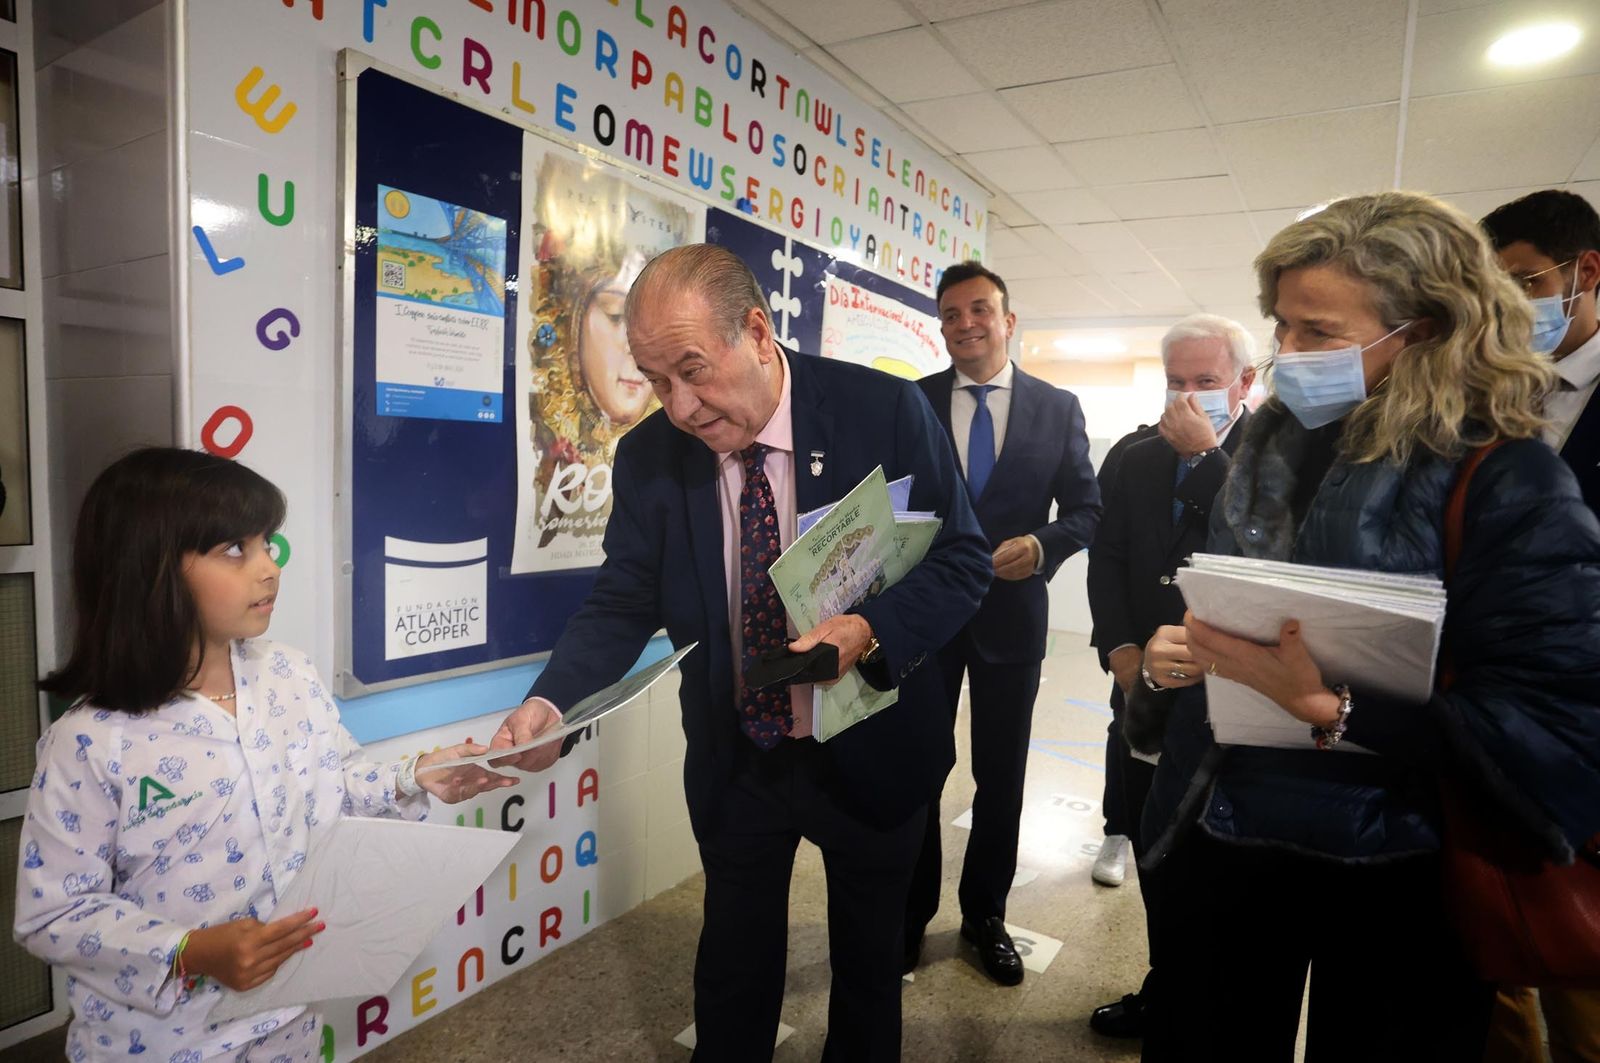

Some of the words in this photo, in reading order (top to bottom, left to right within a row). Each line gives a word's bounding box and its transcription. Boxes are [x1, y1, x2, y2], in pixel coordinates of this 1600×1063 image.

[811, 508, 860, 557] RECORTABLE
[395, 606, 480, 632] ATLANTIC
[405, 623, 470, 646] COPPER
